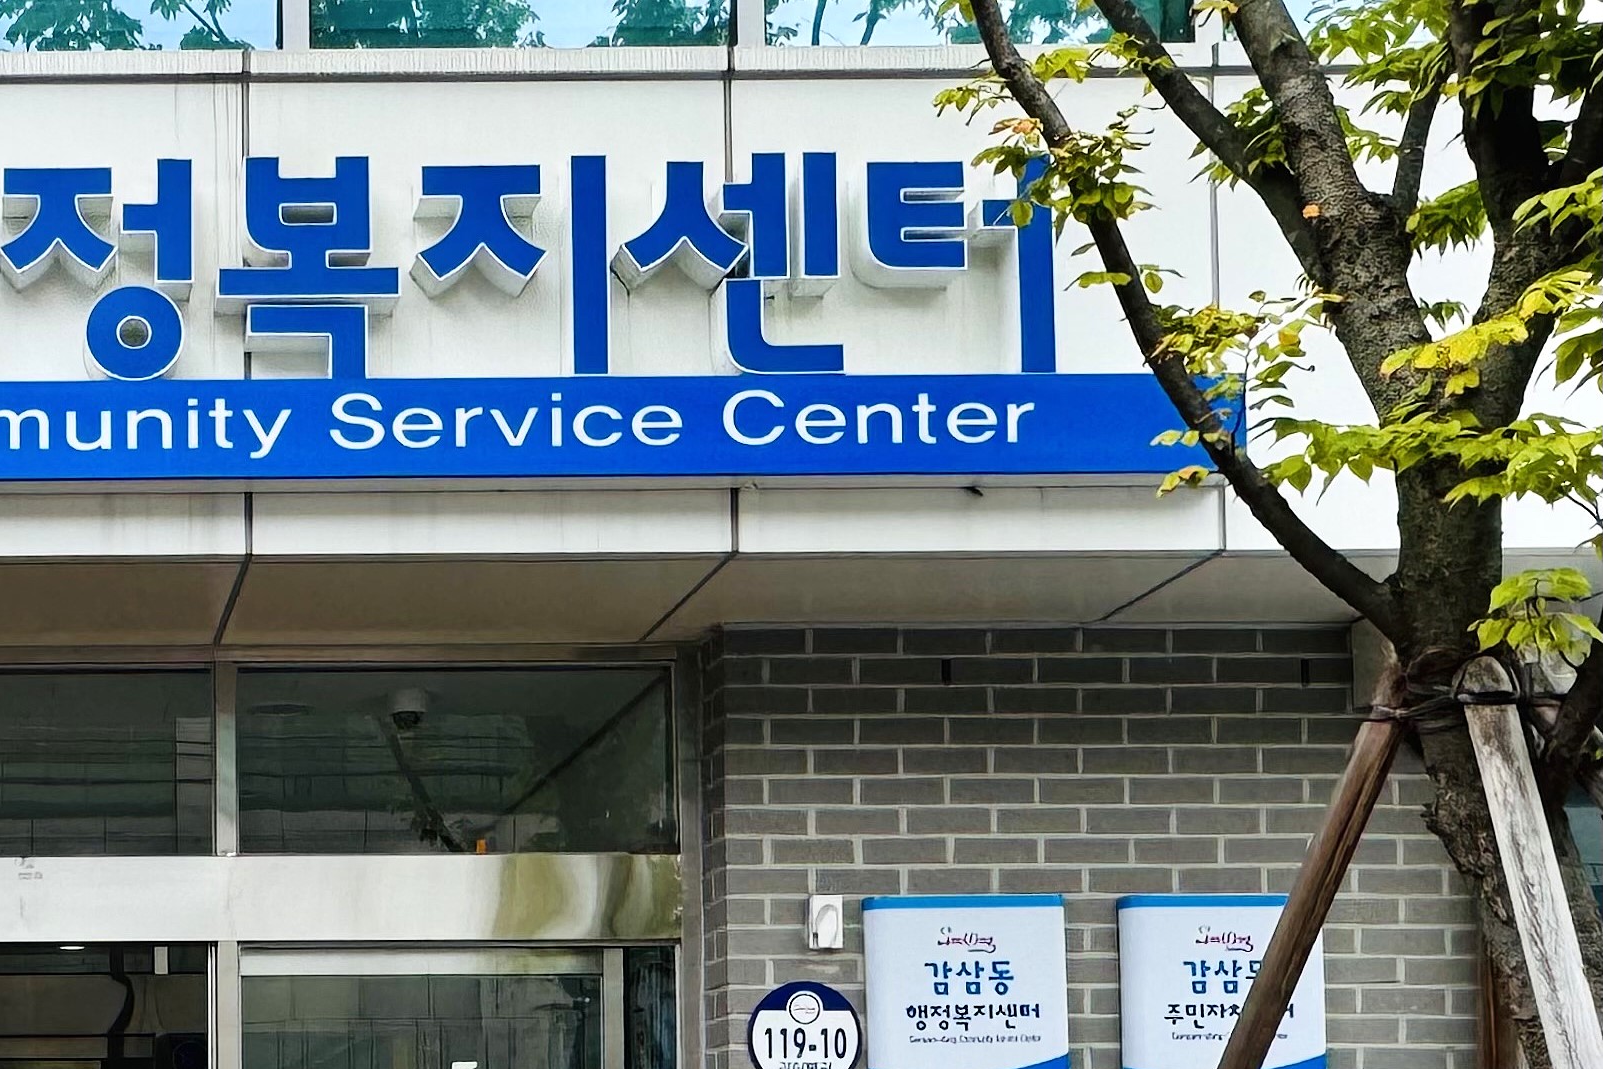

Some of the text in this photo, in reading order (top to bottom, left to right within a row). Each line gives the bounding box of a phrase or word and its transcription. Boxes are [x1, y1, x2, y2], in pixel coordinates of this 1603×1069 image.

[330, 390, 687, 450] Service
[721, 389, 1036, 448] Center
[924, 960, 1015, 996] 감삼동
[765, 1027, 847, 1059] 119-10
